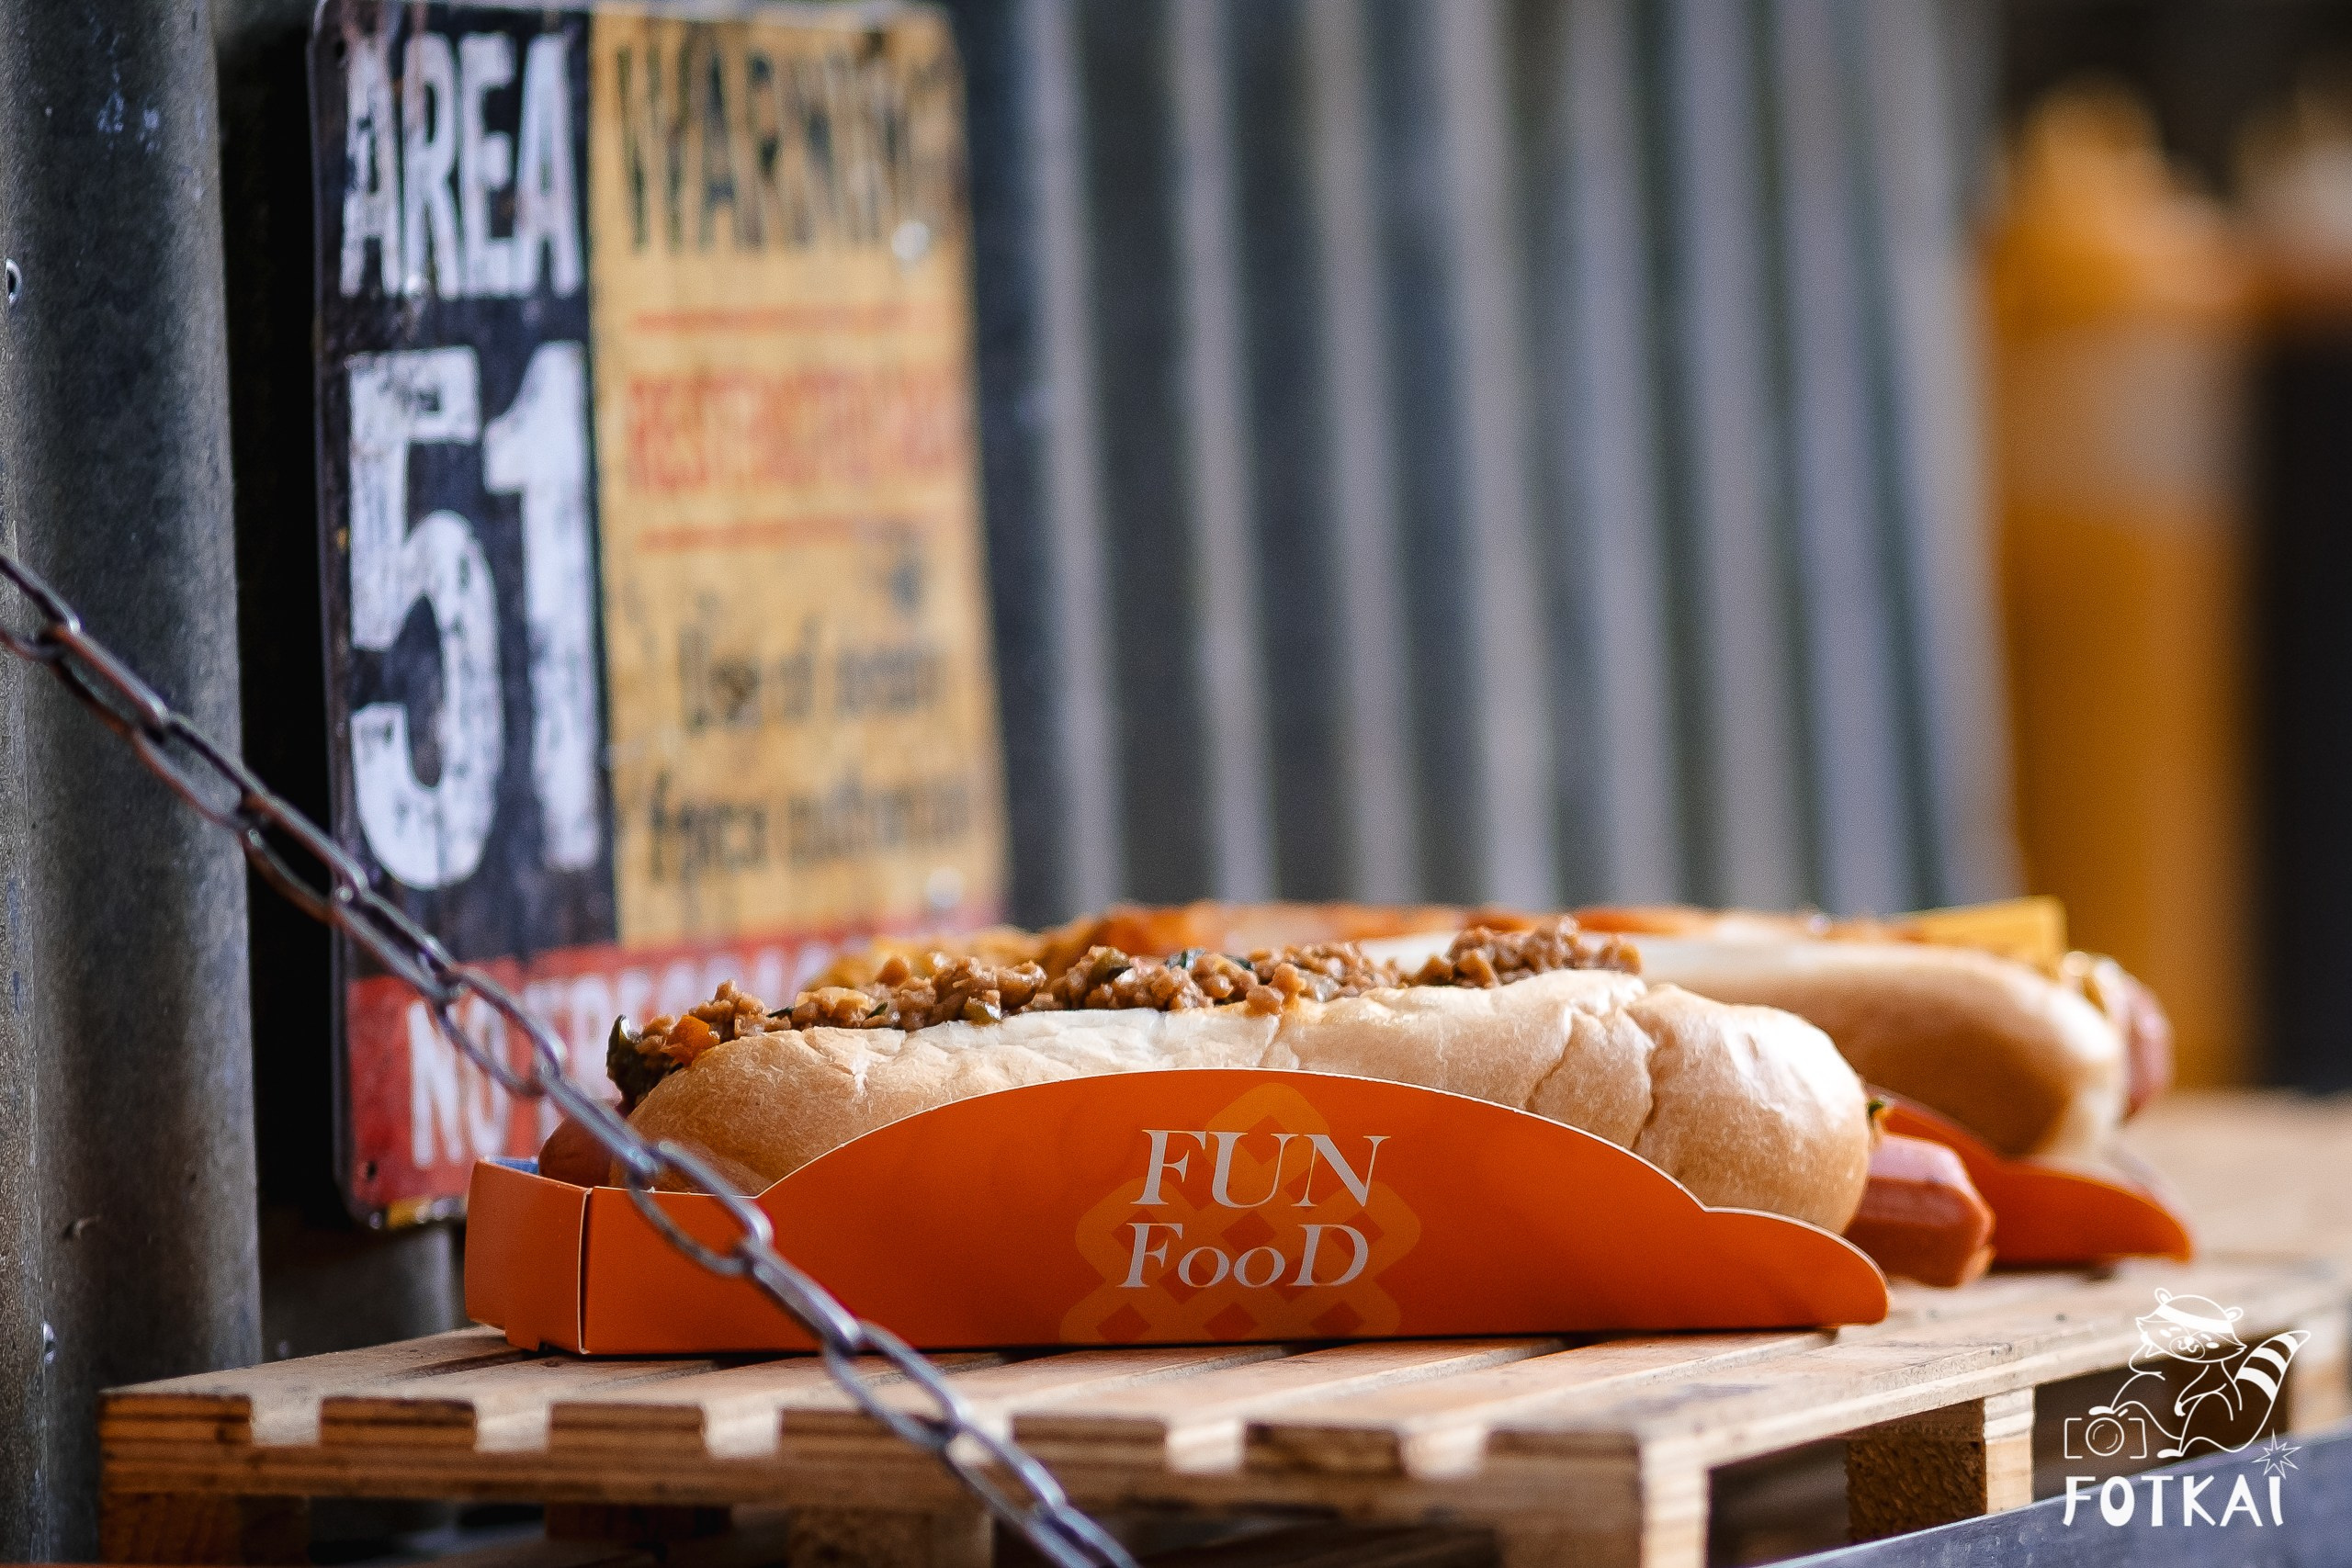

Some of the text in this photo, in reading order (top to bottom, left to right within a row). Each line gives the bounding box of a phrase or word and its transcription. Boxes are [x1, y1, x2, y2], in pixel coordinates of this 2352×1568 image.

[339, 29, 583, 301] AREA
[344, 339, 603, 890] 51
[1128, 1128, 1392, 1209] FUN
